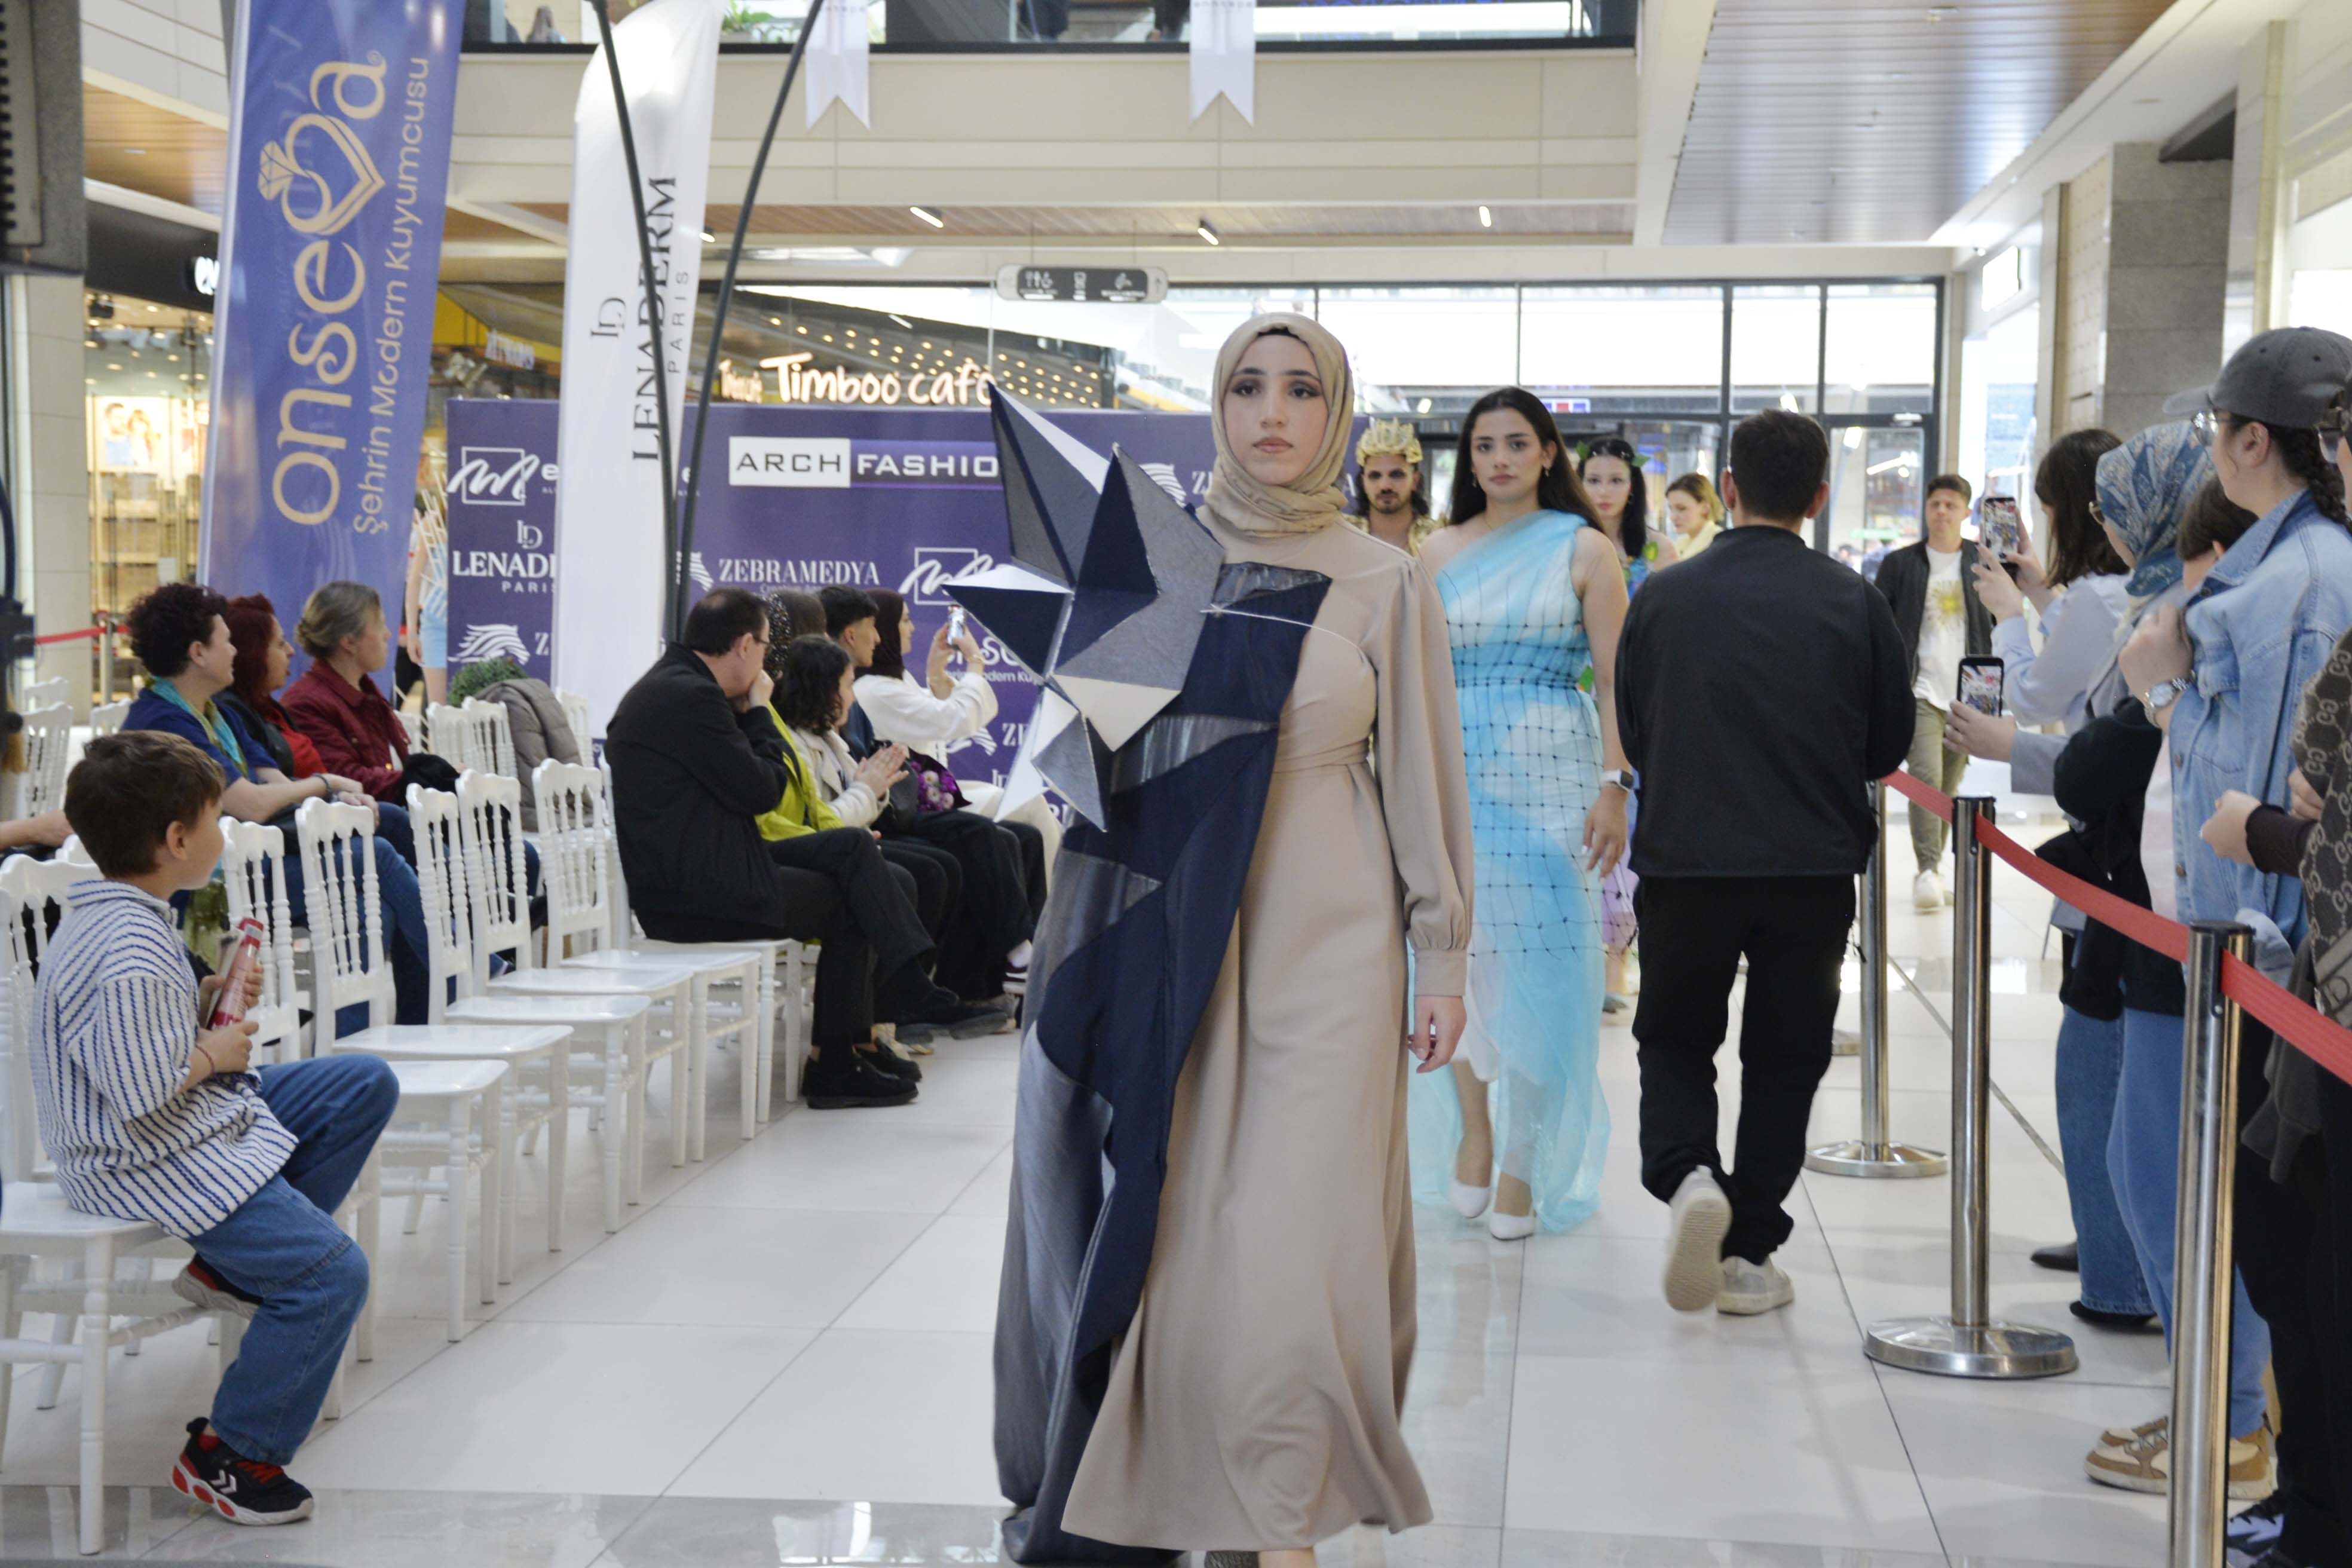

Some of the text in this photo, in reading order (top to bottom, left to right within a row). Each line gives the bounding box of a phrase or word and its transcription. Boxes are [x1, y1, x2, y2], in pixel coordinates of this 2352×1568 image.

[353, 57, 430, 535] Şehrin Modern Kuyumcusu
[667, 272, 688, 373] PARIS
[760, 351, 901, 405] Timboo
[736, 452, 999, 477] ARCH FASHIO
[719, 558, 880, 586] ZEBRAMEDYA
